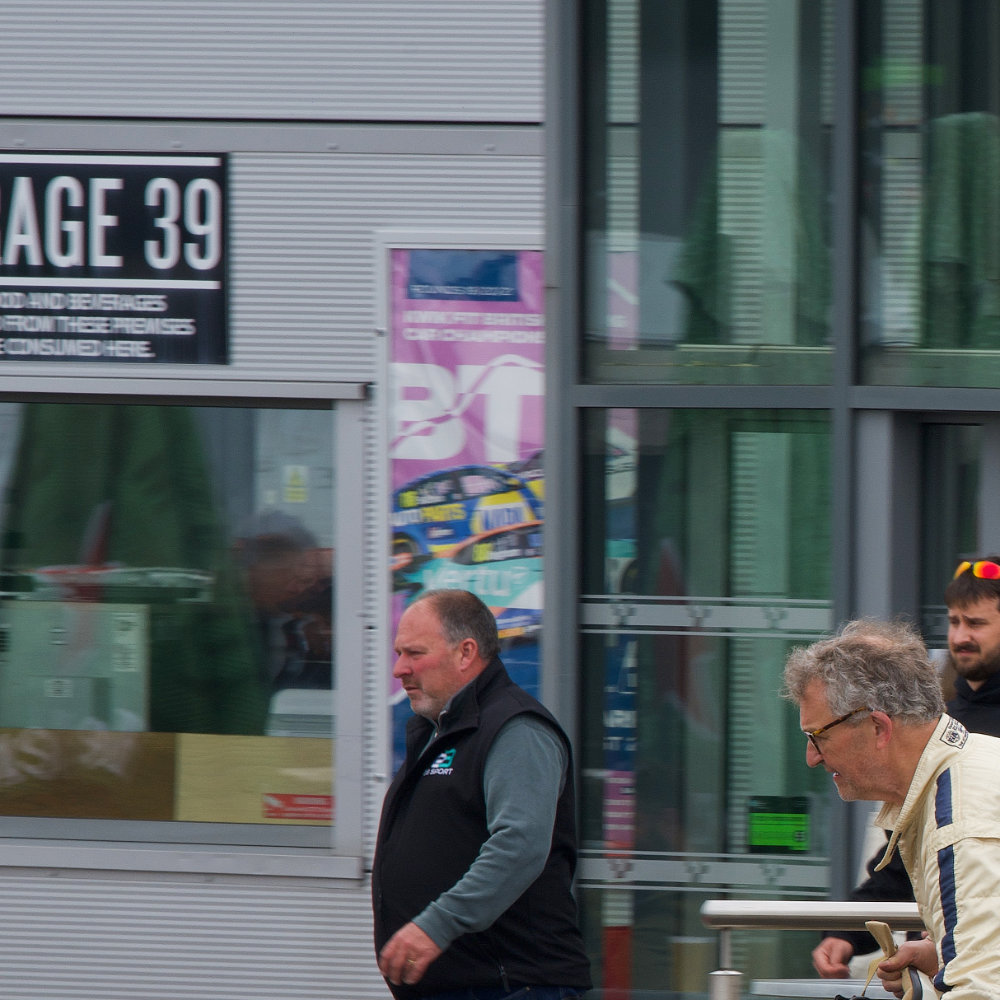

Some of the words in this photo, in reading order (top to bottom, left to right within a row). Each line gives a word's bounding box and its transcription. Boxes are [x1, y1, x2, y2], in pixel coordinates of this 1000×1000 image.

[0, 176, 124, 267] AGE
[144, 177, 221, 270] 39
[429, 768, 454, 776] SPORT
